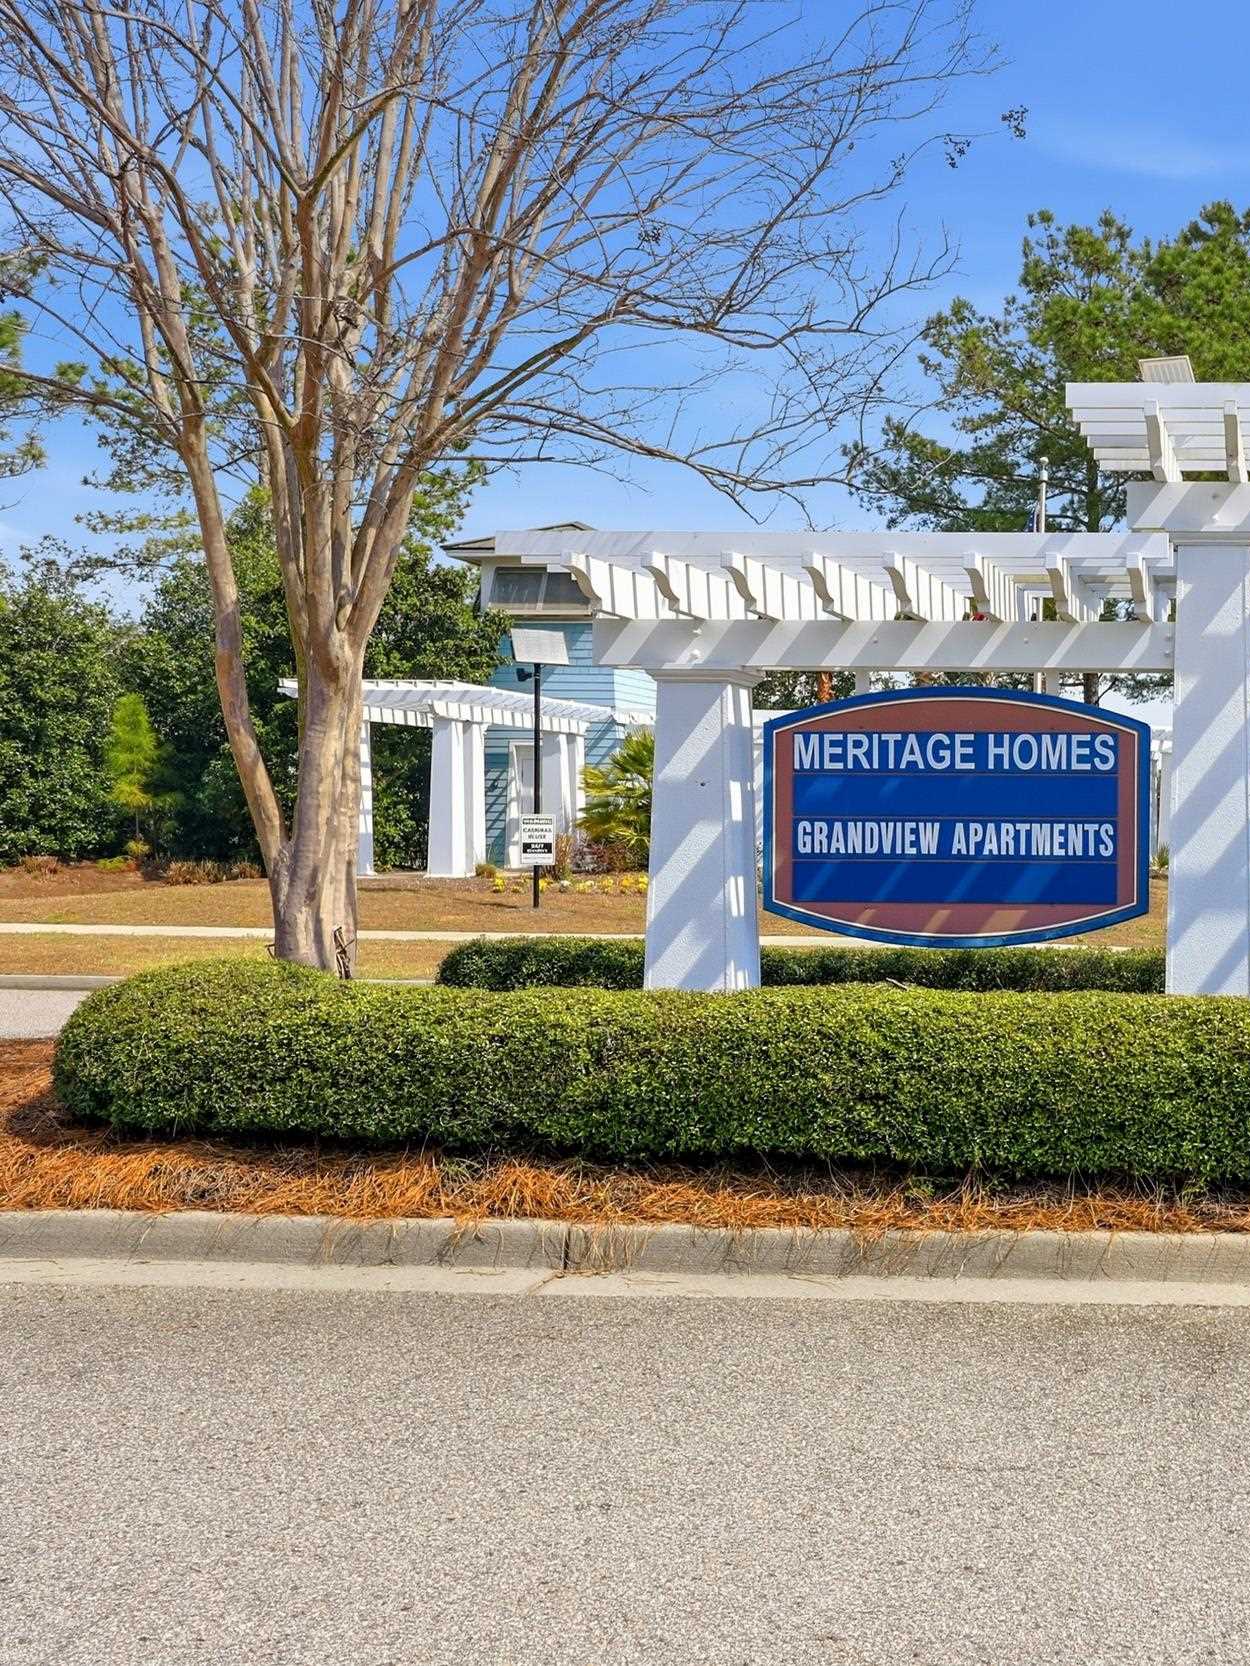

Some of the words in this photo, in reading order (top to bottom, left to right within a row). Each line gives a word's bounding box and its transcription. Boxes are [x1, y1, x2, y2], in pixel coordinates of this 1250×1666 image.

[794, 734, 976, 770] MERITAGE
[988, 734, 1116, 771] HOMES
[798, 821, 940, 855] GRANDVIEW
[952, 822, 1114, 857] APARTMENTS
